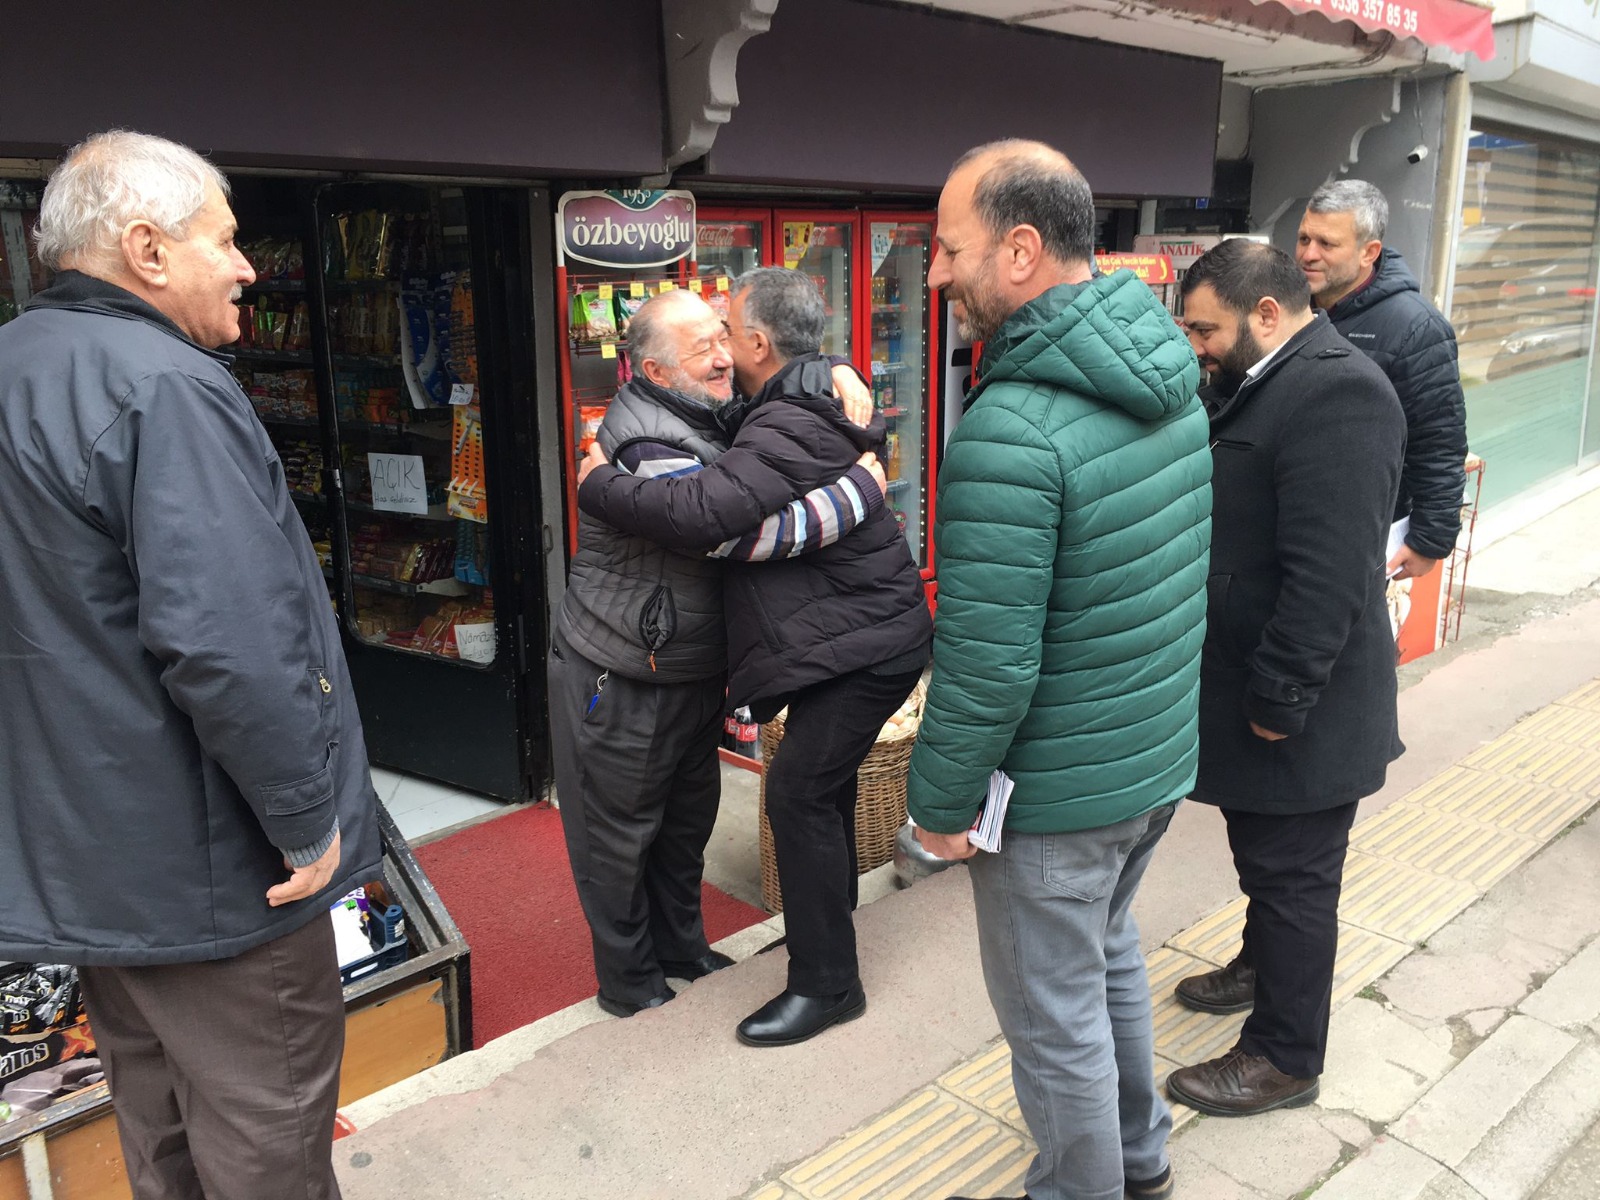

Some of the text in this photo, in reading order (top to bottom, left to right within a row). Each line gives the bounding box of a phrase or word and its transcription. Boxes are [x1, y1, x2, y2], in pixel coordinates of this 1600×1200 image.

[1362, 0, 1384, 22] 357
[1386, 4, 1401, 27] 85
[1403, 9, 1417, 32] 35
[572, 214, 690, 251] özbeyoğlu
[373, 458, 421, 491] AÇIK
